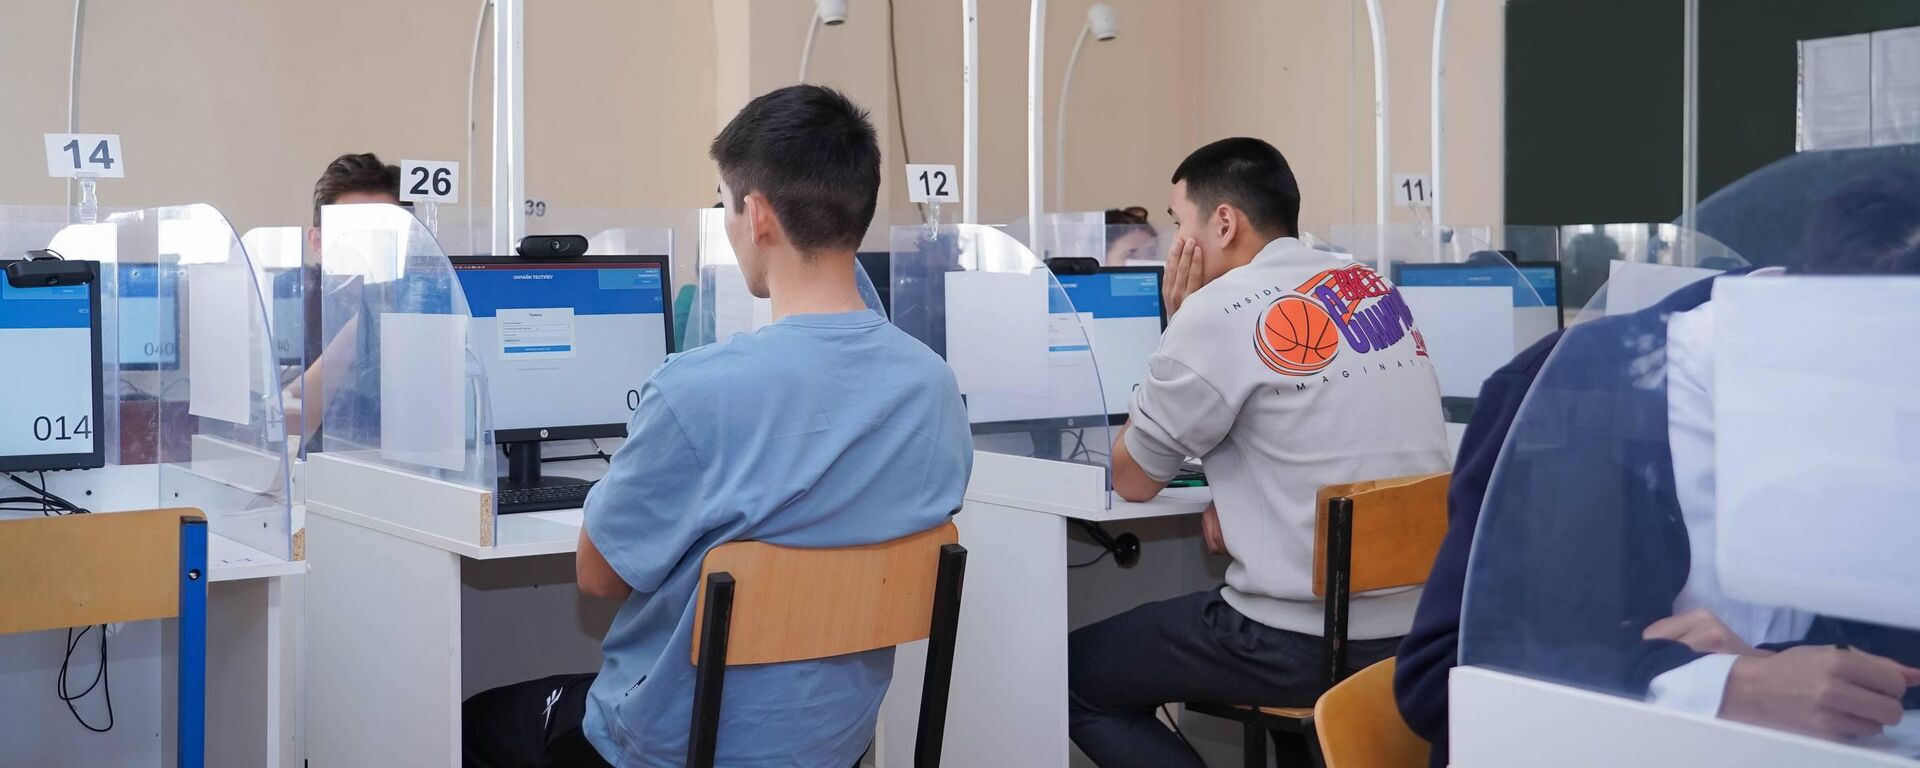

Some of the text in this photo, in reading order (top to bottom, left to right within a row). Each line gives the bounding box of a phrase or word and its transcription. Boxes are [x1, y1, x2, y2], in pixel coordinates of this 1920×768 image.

[63, 139, 115, 170] 14
[409, 166, 452, 196] 26
[919, 170, 949, 196] 12
[1402, 178, 1432, 201] 11
[524, 199, 546, 217] 39
[1224, 286, 1282, 314] INSIDE
[33, 415, 92, 441] 014
